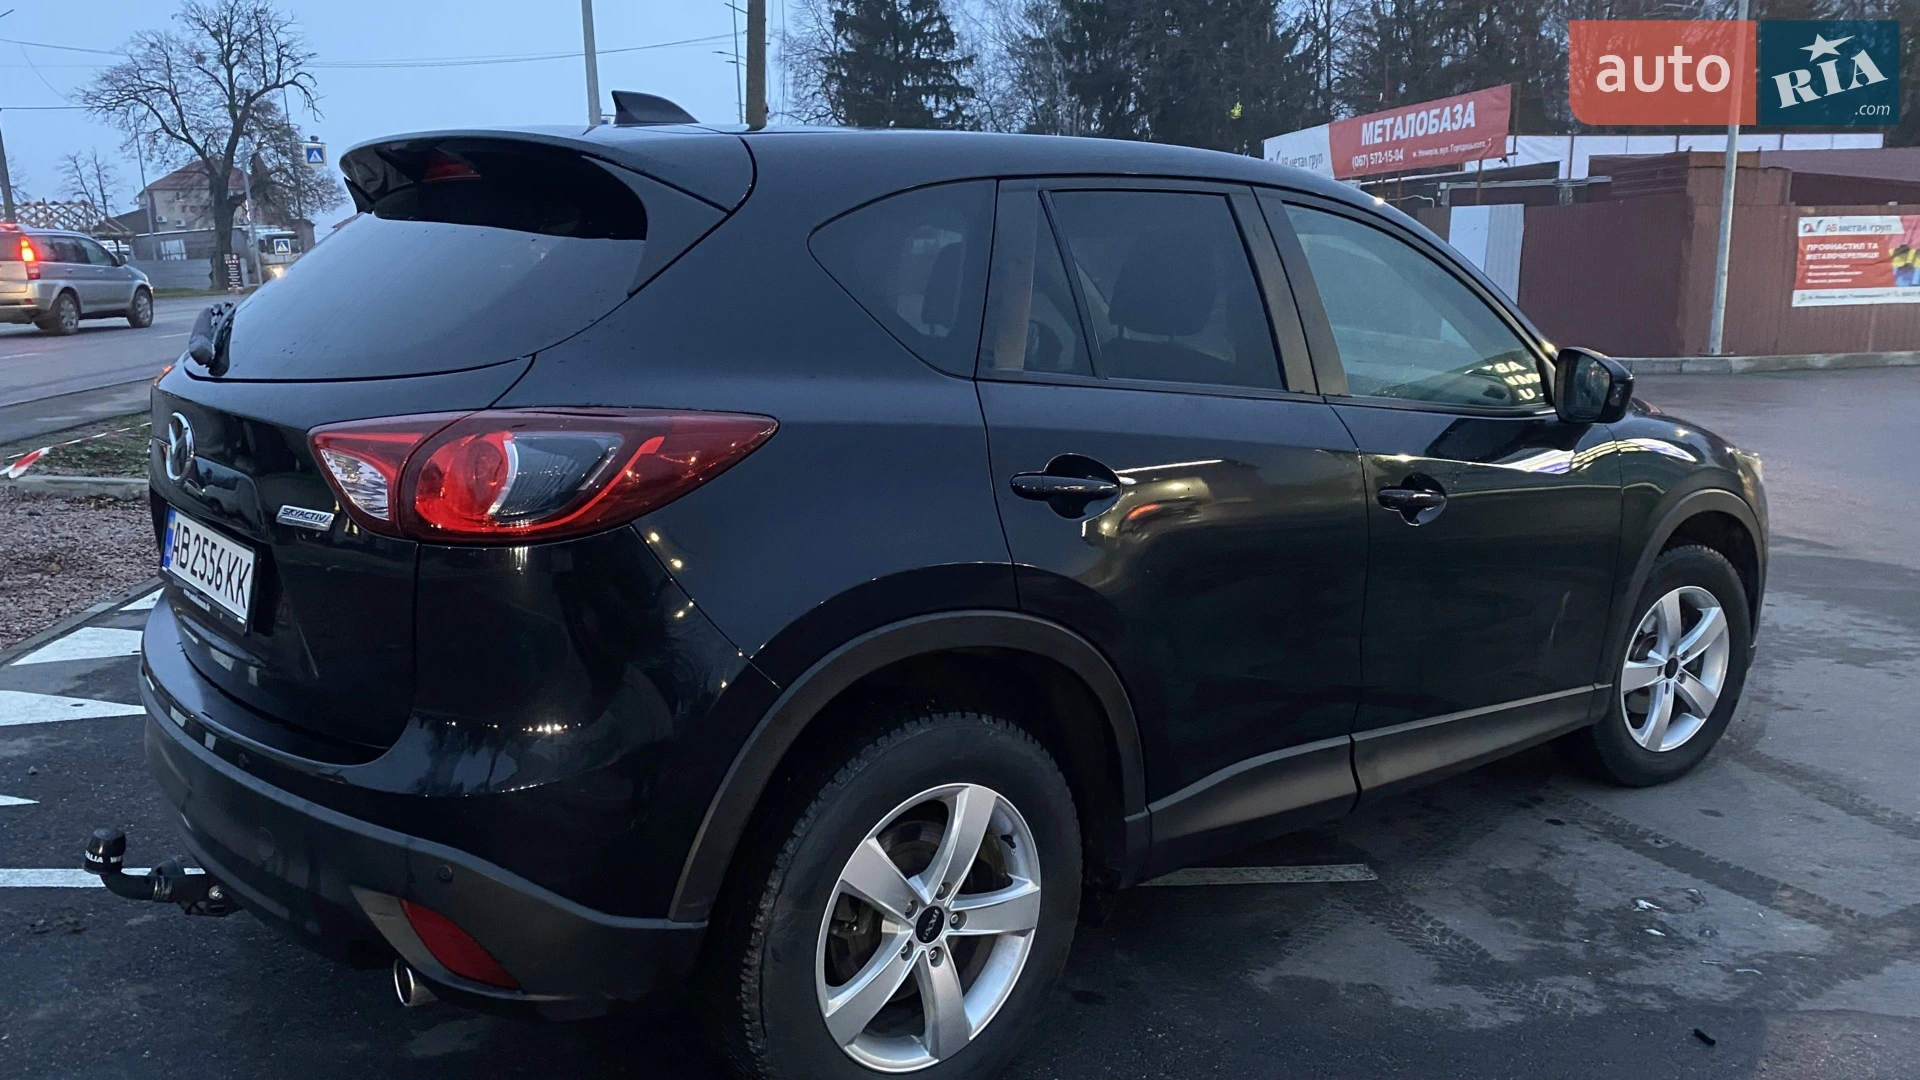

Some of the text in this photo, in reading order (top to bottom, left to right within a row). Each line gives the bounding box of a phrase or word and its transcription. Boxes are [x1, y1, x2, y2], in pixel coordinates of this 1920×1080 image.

[1361, 101, 1476, 146] МЕТАЛОБАЗА
[1352, 148, 1404, 170] (067) 572-15-04
[1839, 223, 1867, 232] метал
[1870, 224, 1892, 234] груп
[282, 507, 327, 521] SKYACTIV
[171, 522, 191, 570] AB
[190, 533, 226, 592] 2556
[224, 551, 252, 609] KK
